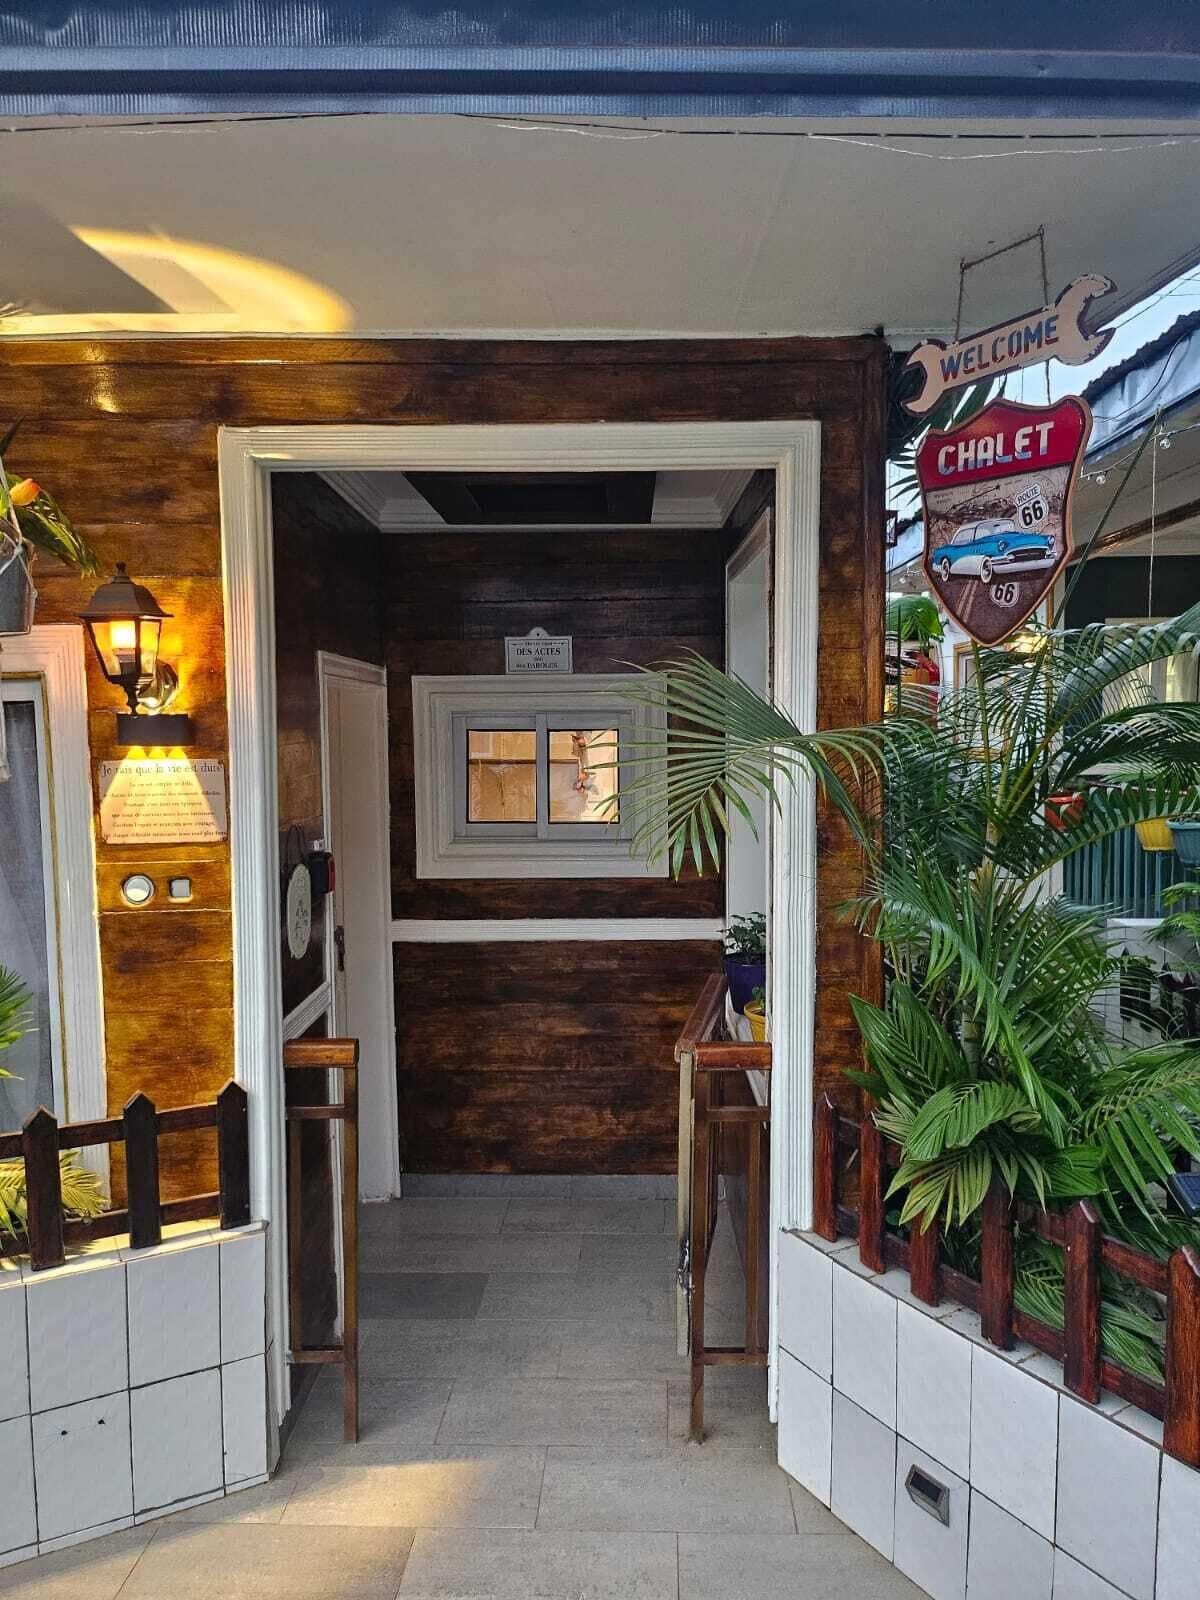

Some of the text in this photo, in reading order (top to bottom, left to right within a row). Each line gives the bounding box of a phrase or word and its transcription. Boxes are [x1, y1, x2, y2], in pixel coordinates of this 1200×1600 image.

[939, 314, 1060, 382] WELCOME
[938, 421, 1054, 475] CHALET
[1017, 485, 1038, 503] ROUTE
[1022, 500, 1043, 526] 66
[994, 583, 1015, 603] 66
[516, 647, 561, 656] DES ACTES
